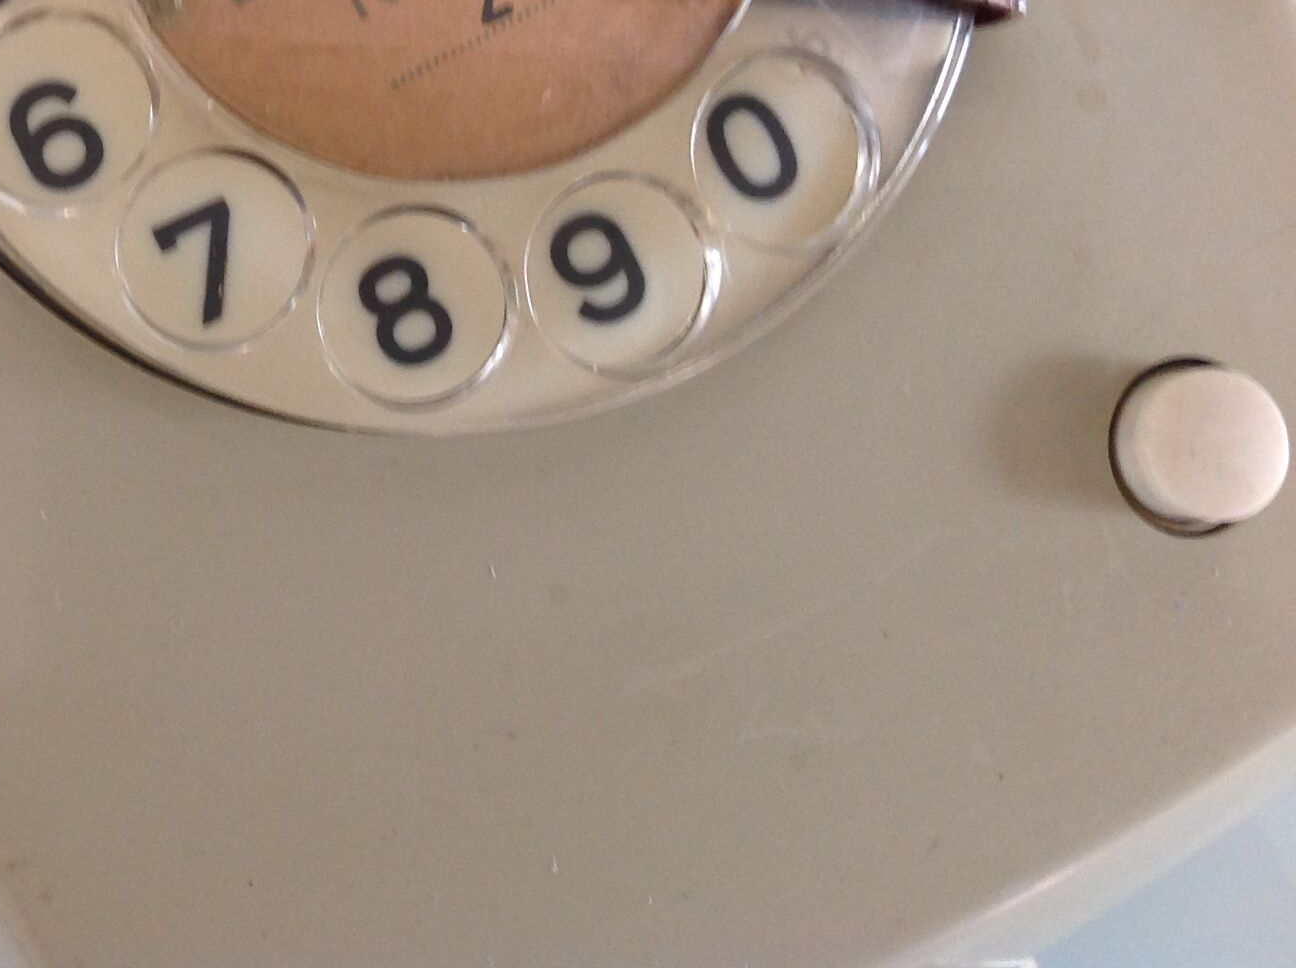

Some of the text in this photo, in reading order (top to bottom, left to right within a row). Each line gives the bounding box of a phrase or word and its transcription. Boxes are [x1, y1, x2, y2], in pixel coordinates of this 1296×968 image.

[9, 78, 104, 191] 6
[706, 92, 798, 202] 0
[152, 196, 231, 326] 7
[358, 255, 453, 366] 8
[550, 213, 646, 325] 9
